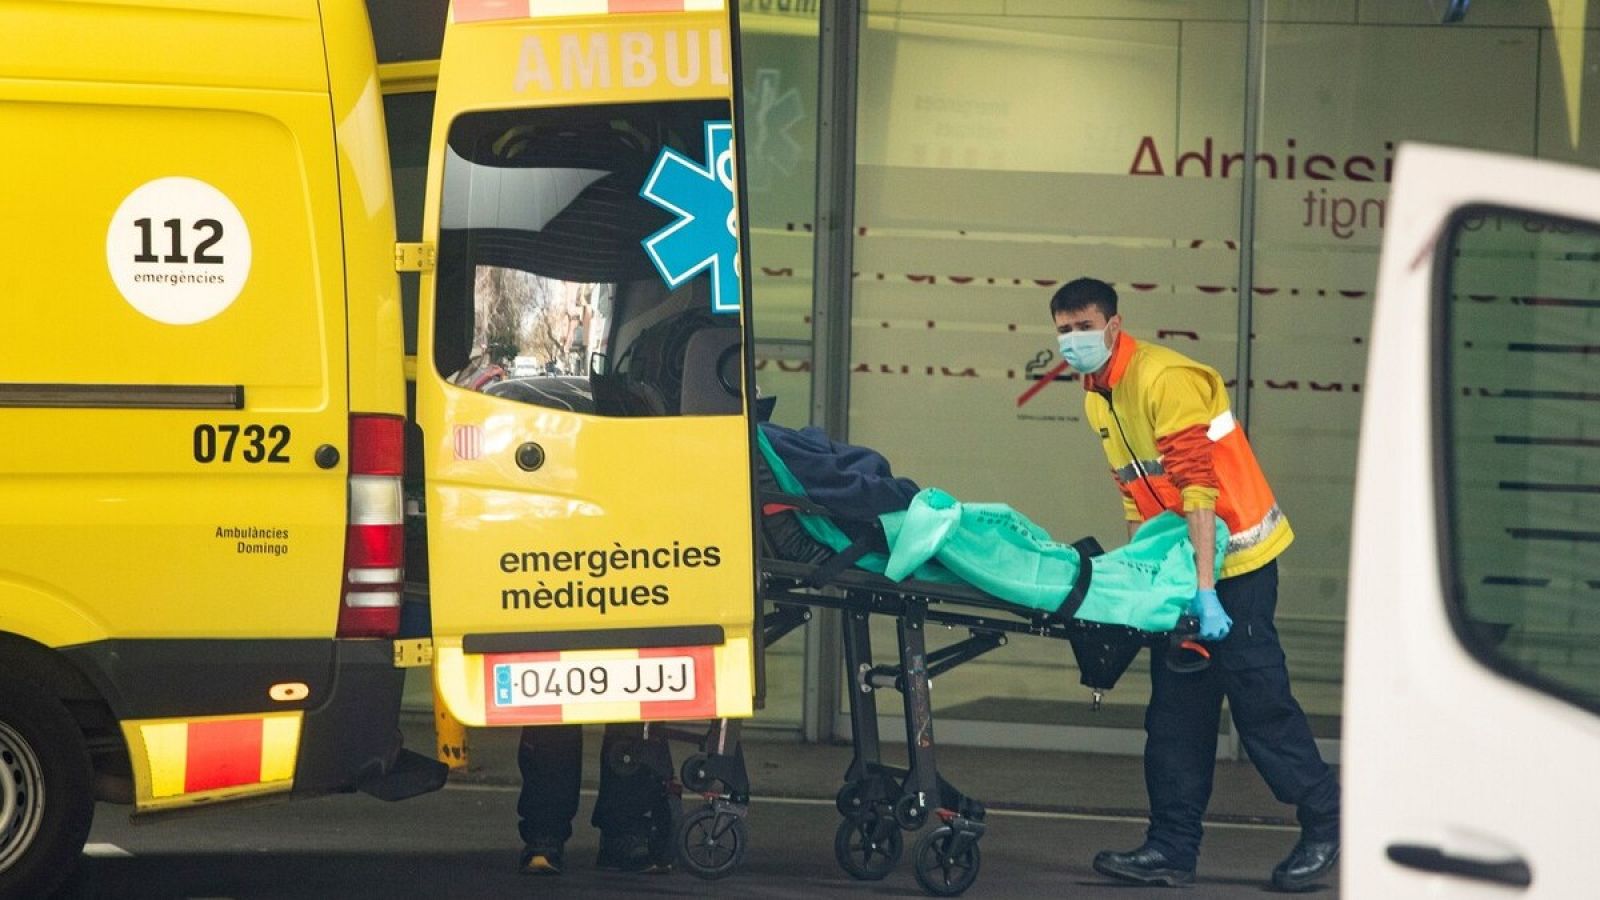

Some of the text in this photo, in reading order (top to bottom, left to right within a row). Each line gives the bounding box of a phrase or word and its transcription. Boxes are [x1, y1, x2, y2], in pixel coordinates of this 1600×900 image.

[513, 30, 728, 93] AMBUL
[133, 217, 225, 264] 112
[133, 270, 225, 286] emergències
[193, 424, 291, 464] 0732
[215, 526, 289, 540] Ambulàncies
[237, 541, 288, 556] Domingo
[499, 541, 721, 577] emergències
[501, 581, 669, 614] mèdiques
[520, 666, 608, 698] 0409
[623, 663, 688, 694] JJJ
